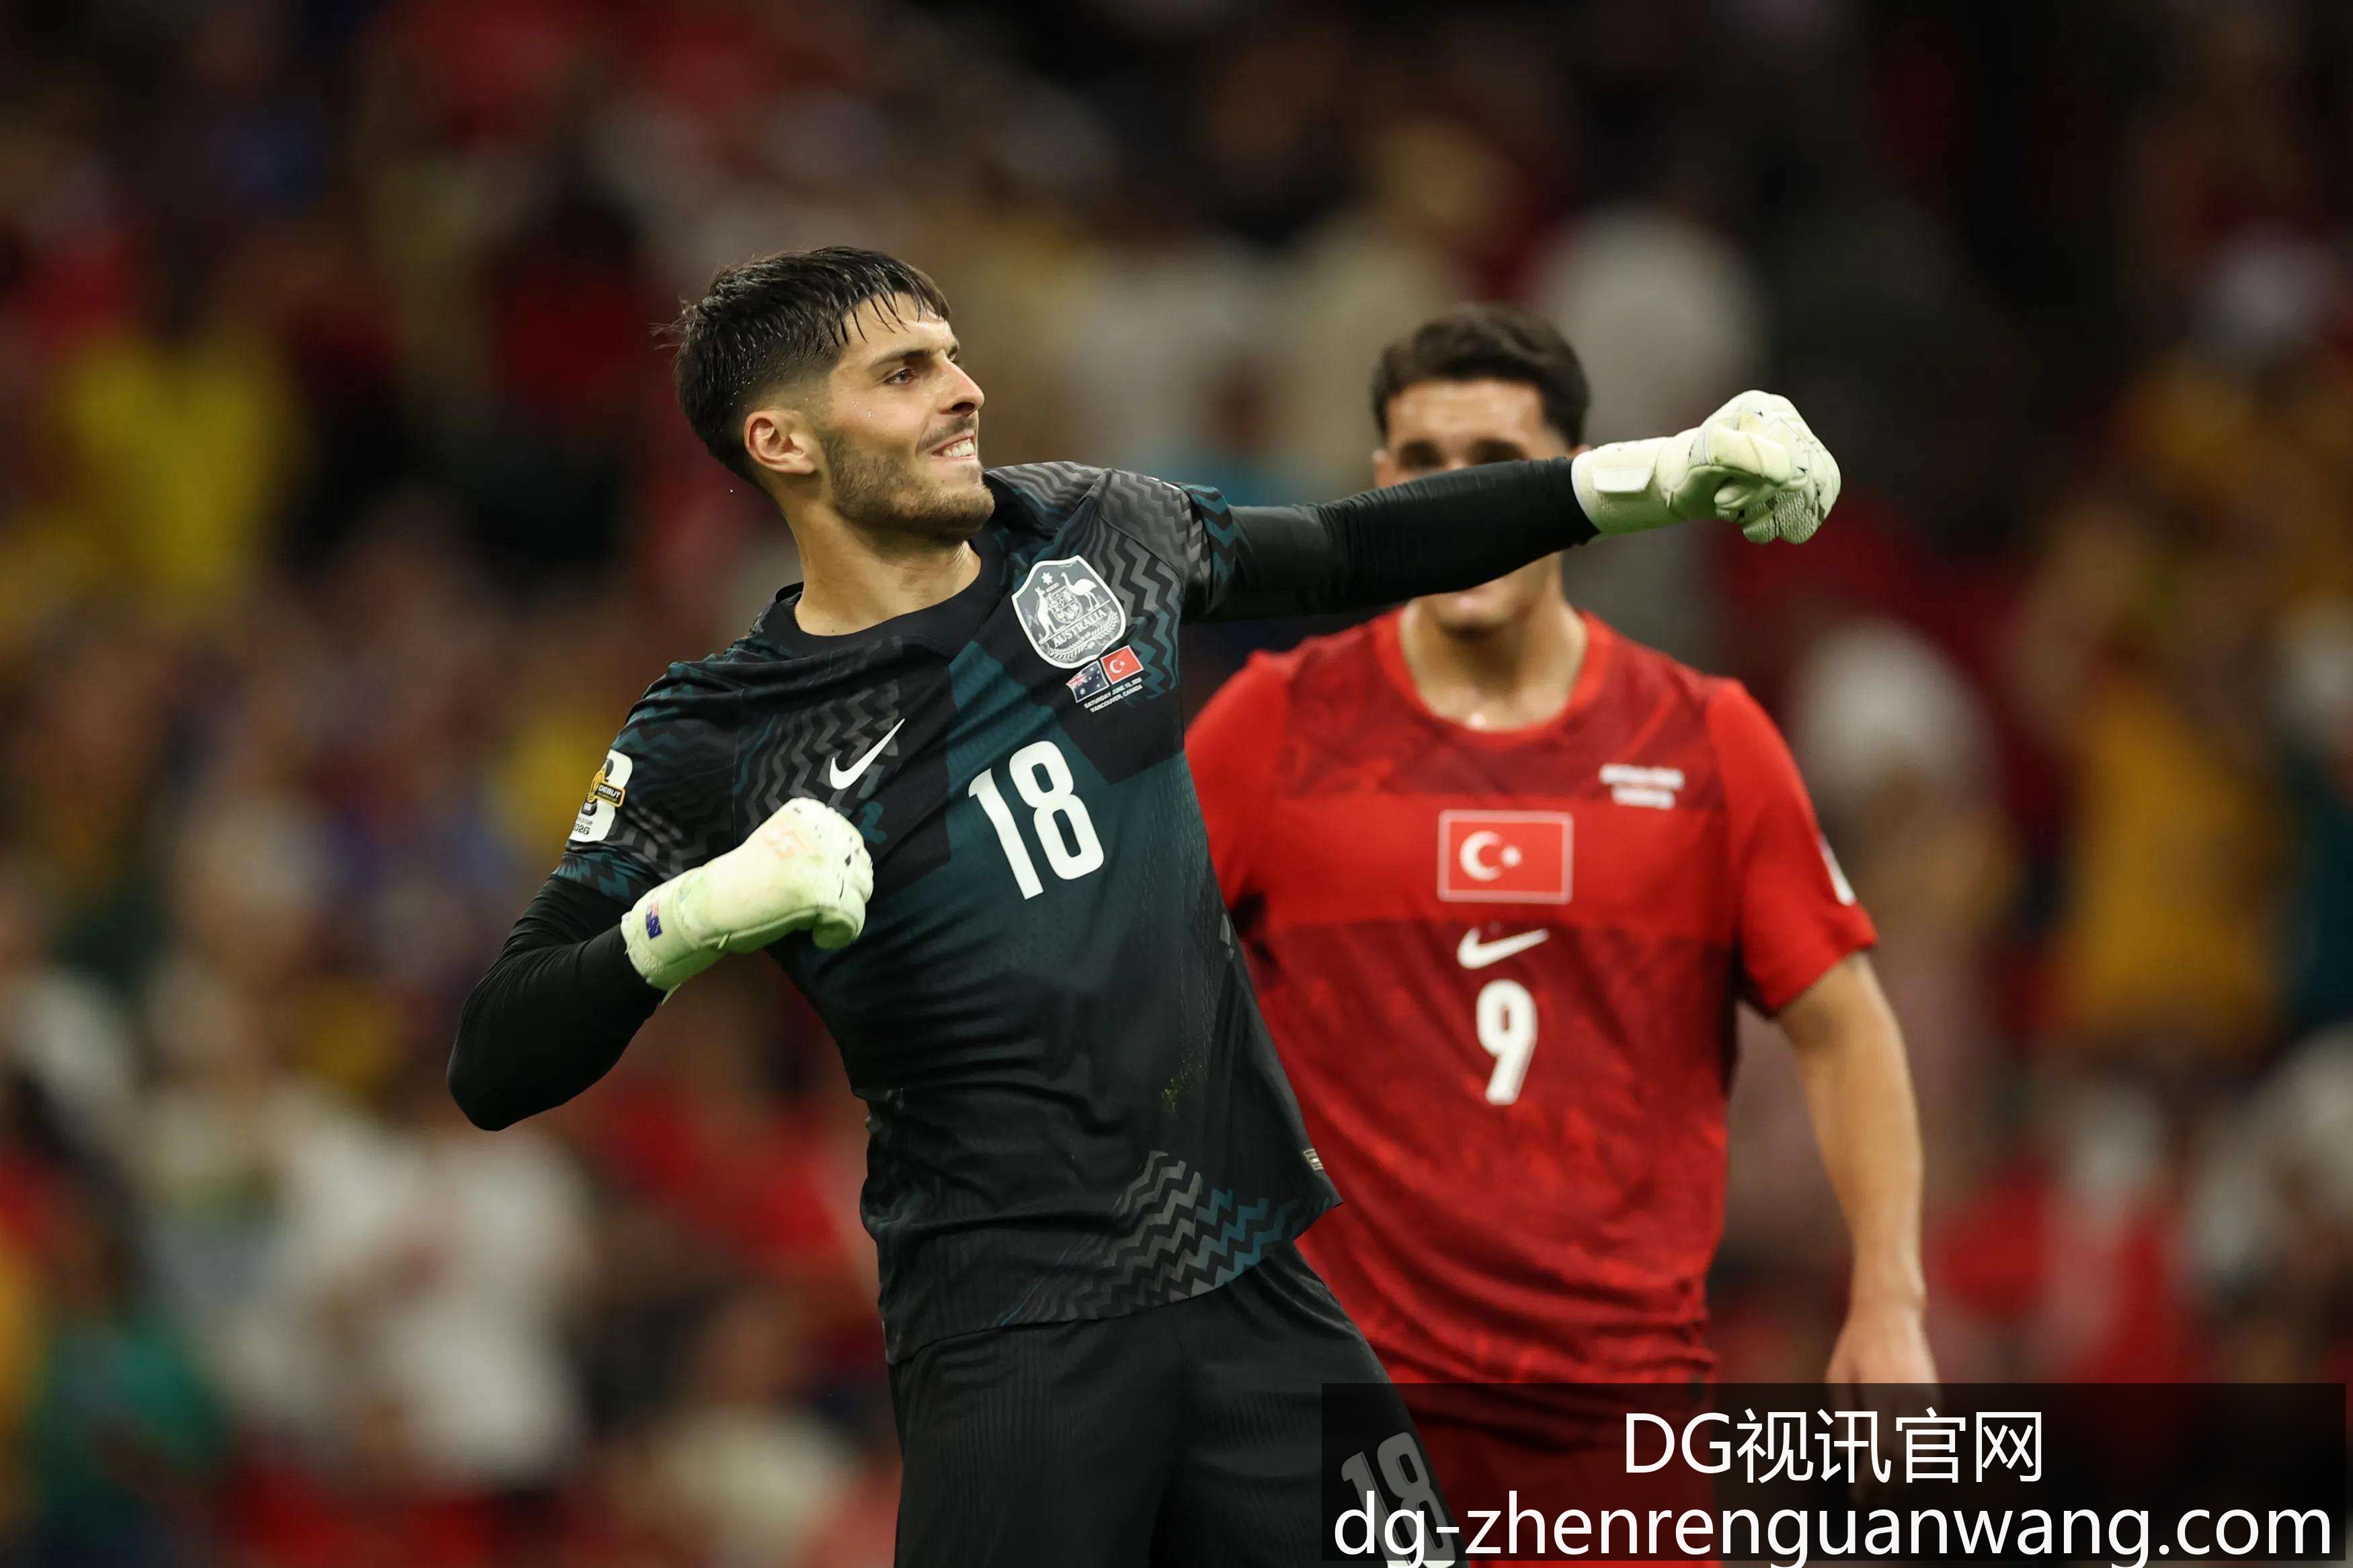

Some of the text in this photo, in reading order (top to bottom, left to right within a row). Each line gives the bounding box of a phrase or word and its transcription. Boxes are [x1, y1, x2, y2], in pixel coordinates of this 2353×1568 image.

[1053, 609, 1108, 648] AUSTRALIA
[1084, 691, 1111, 709] SATURDAY
[1112, 684, 1125, 695] JUNE
[598, 784, 621, 798] DEBUT
[574, 823, 590, 835] 026
[968, 740, 1105, 900] 18
[1476, 978, 1539, 1106] 9
[1341, 1432, 1457, 1568] 18
